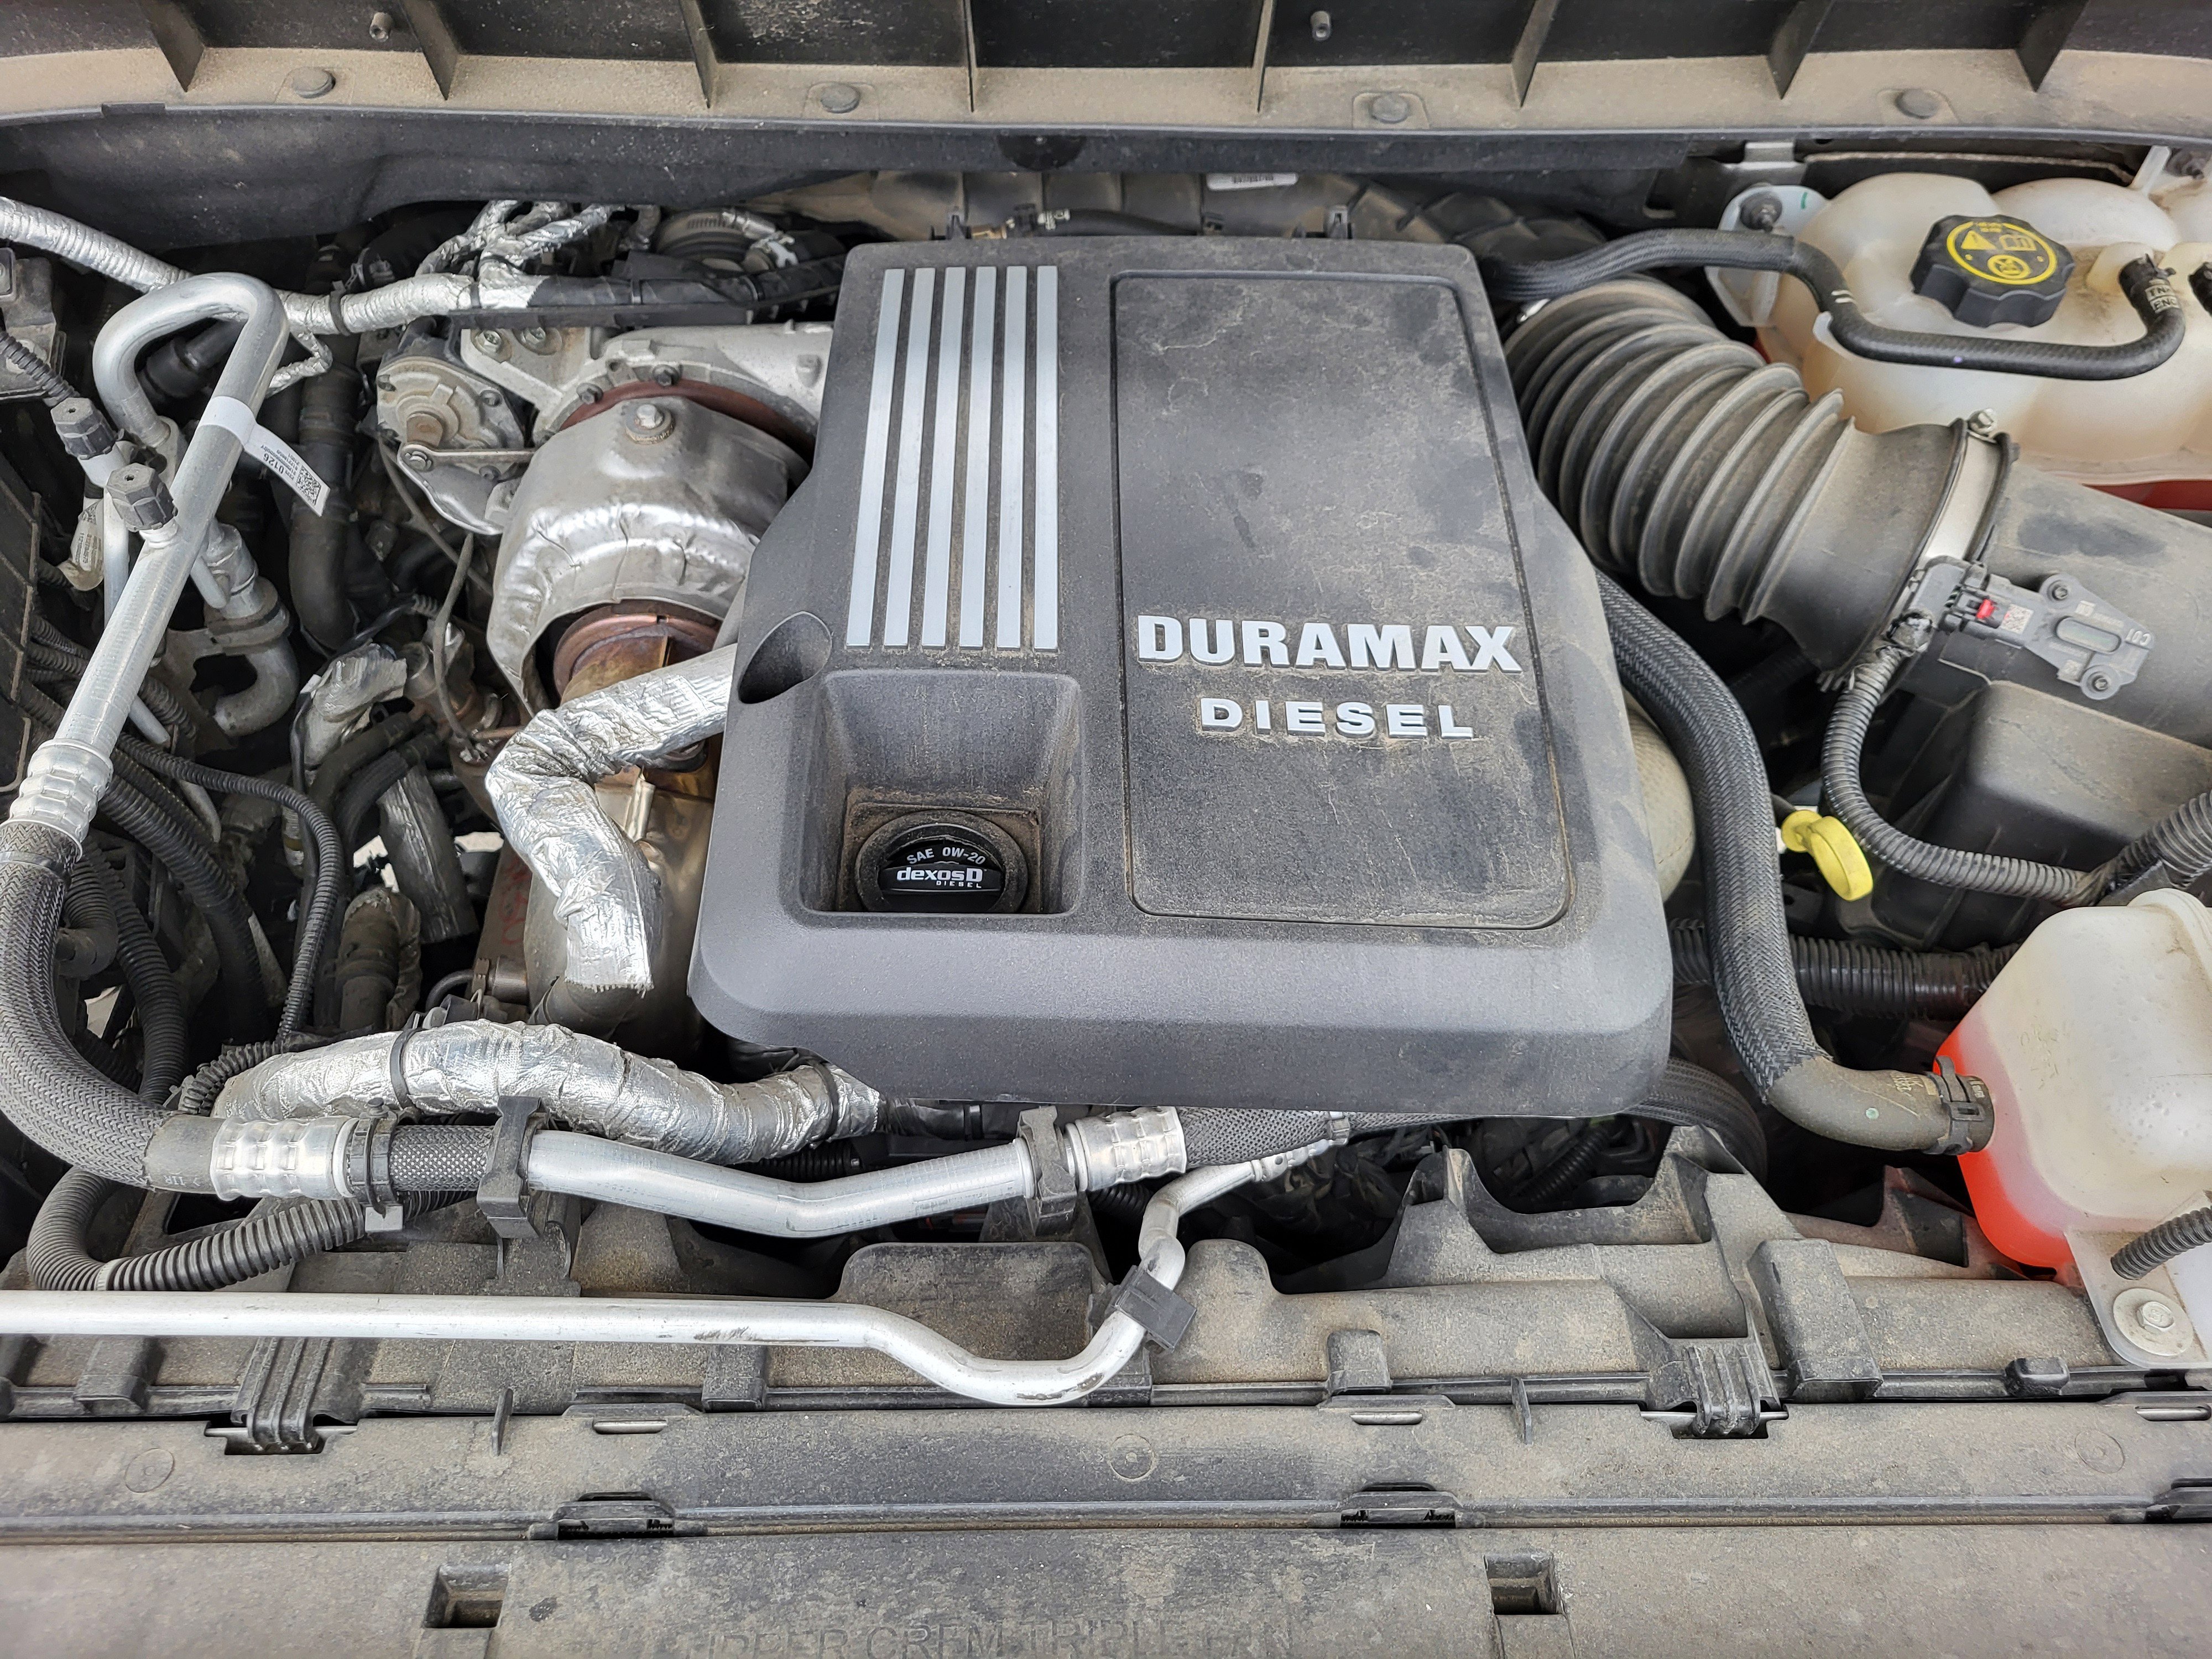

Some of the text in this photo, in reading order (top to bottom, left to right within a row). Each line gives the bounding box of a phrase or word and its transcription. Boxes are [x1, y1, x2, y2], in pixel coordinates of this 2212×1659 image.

[1138, 614, 1522, 673] DURAMAX
[1199, 697, 1474, 740] DIESEL
[906, 846, 987, 865] SAE 0W-20
